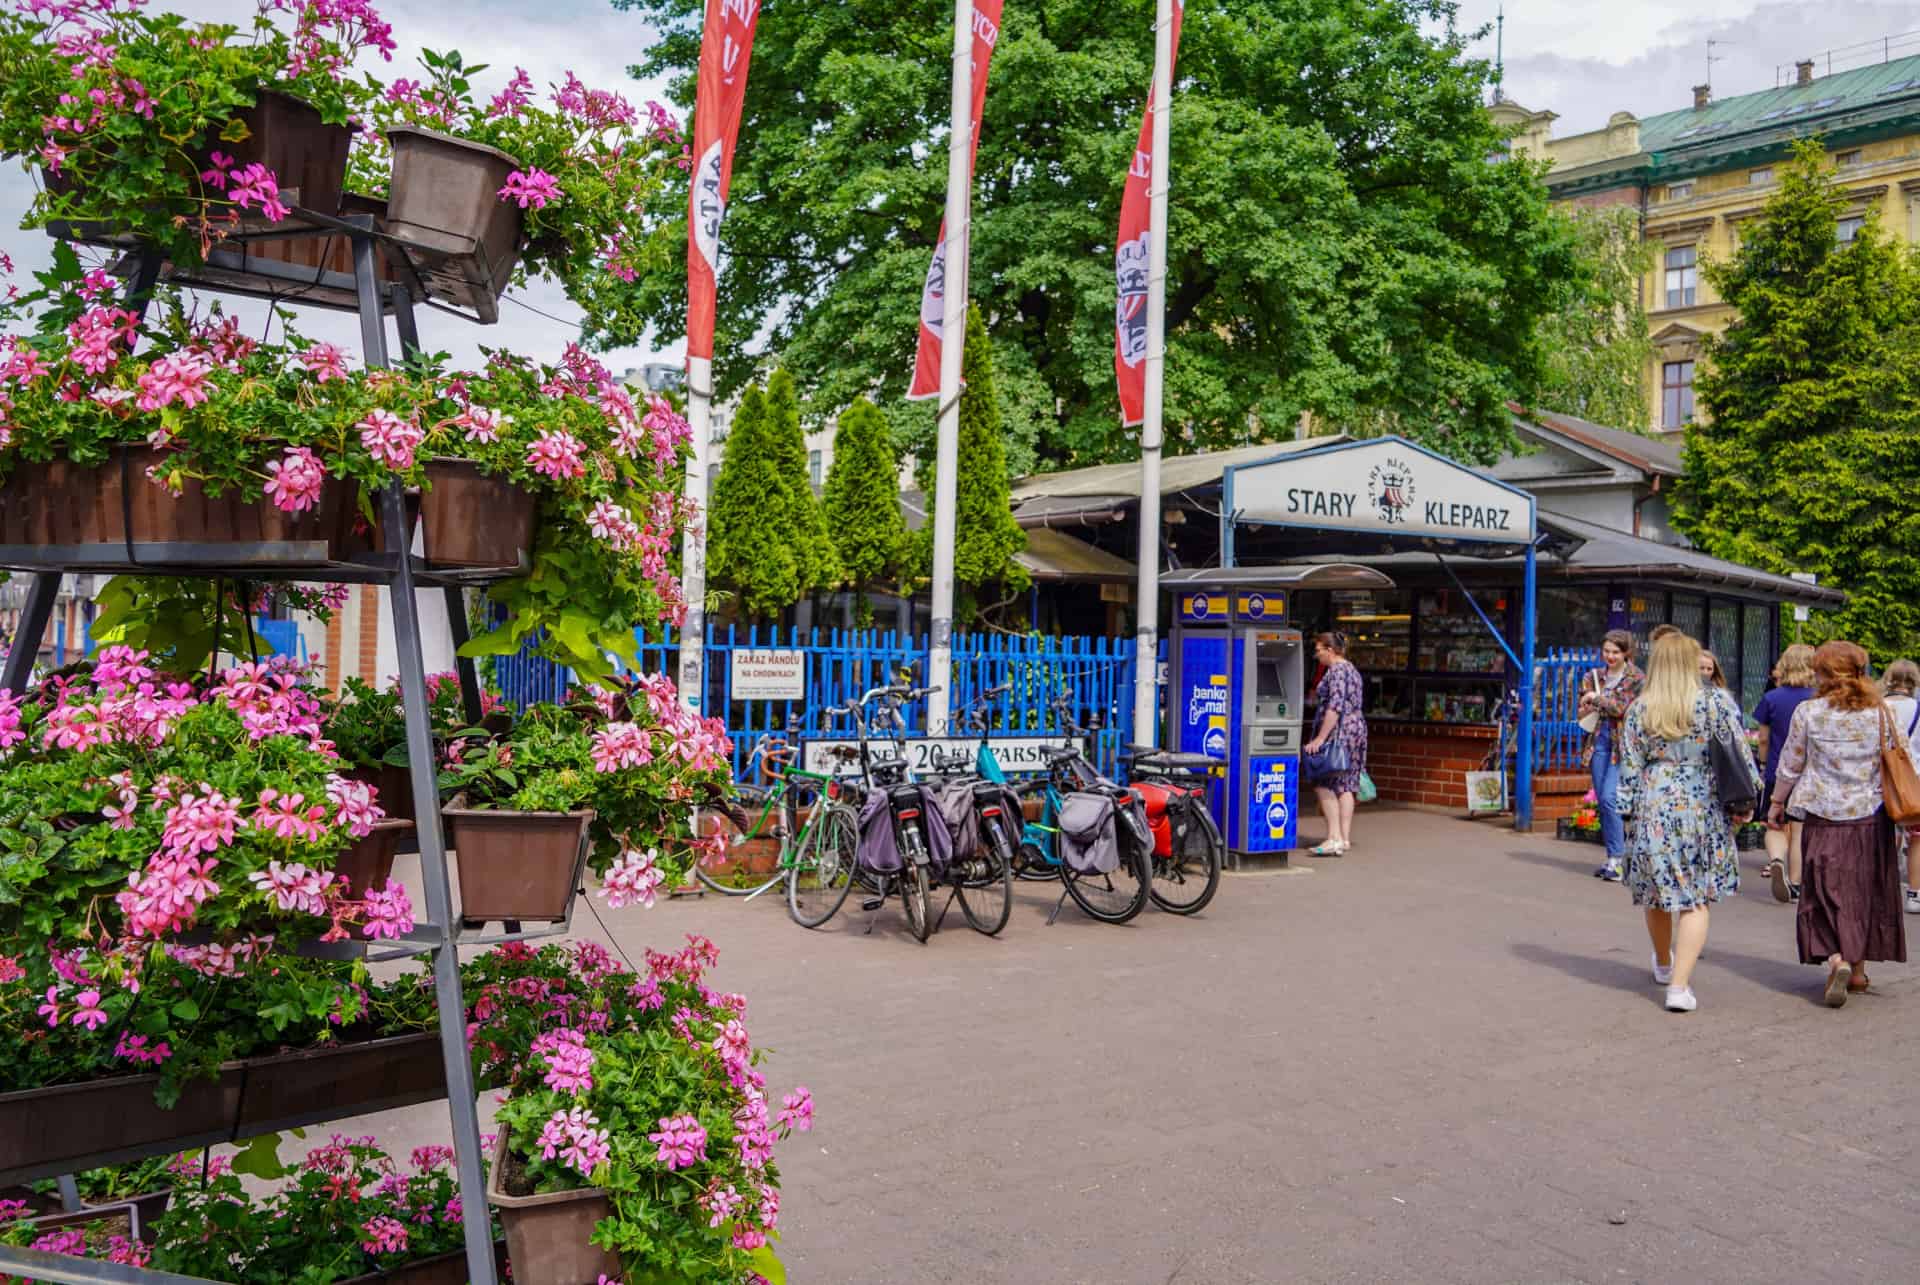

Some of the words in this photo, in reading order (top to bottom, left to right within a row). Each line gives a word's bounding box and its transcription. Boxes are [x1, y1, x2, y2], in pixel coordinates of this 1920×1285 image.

[1287, 488, 1357, 518] STARY
[1425, 500, 1512, 531] KLEPARZ
[737, 656, 766, 664] ZAKAZ
[1194, 685, 1227, 700] banko
[1205, 700, 1226, 713] mat
[1259, 772, 1285, 784] banko
